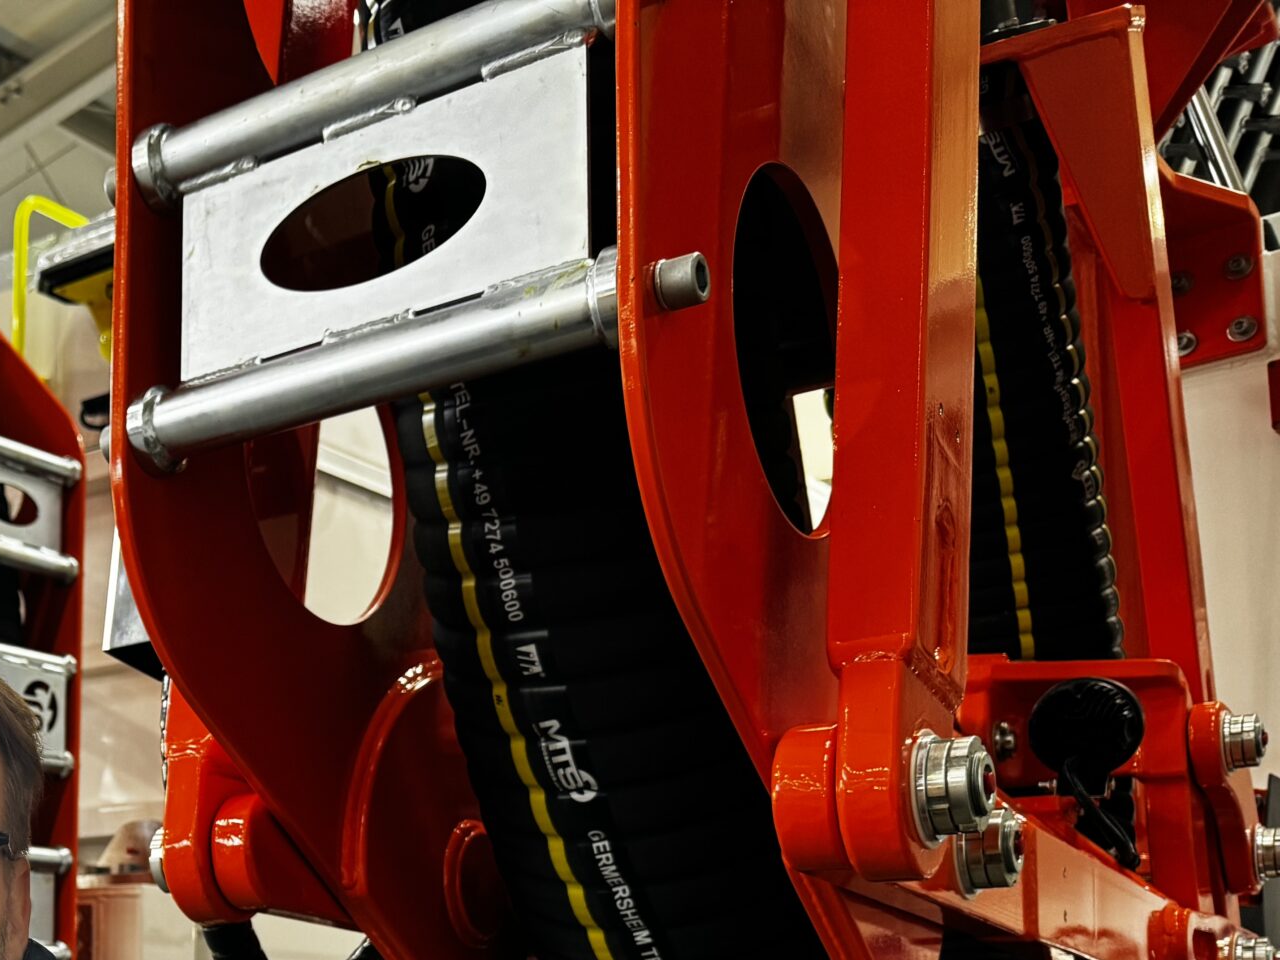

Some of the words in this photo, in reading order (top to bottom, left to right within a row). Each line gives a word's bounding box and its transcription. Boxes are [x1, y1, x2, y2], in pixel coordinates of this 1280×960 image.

[471, 469, 491, 506] +49
[481, 507, 501, 555] 7274
[493, 557, 524, 623] 500600
[537, 718, 599, 804] MTS
